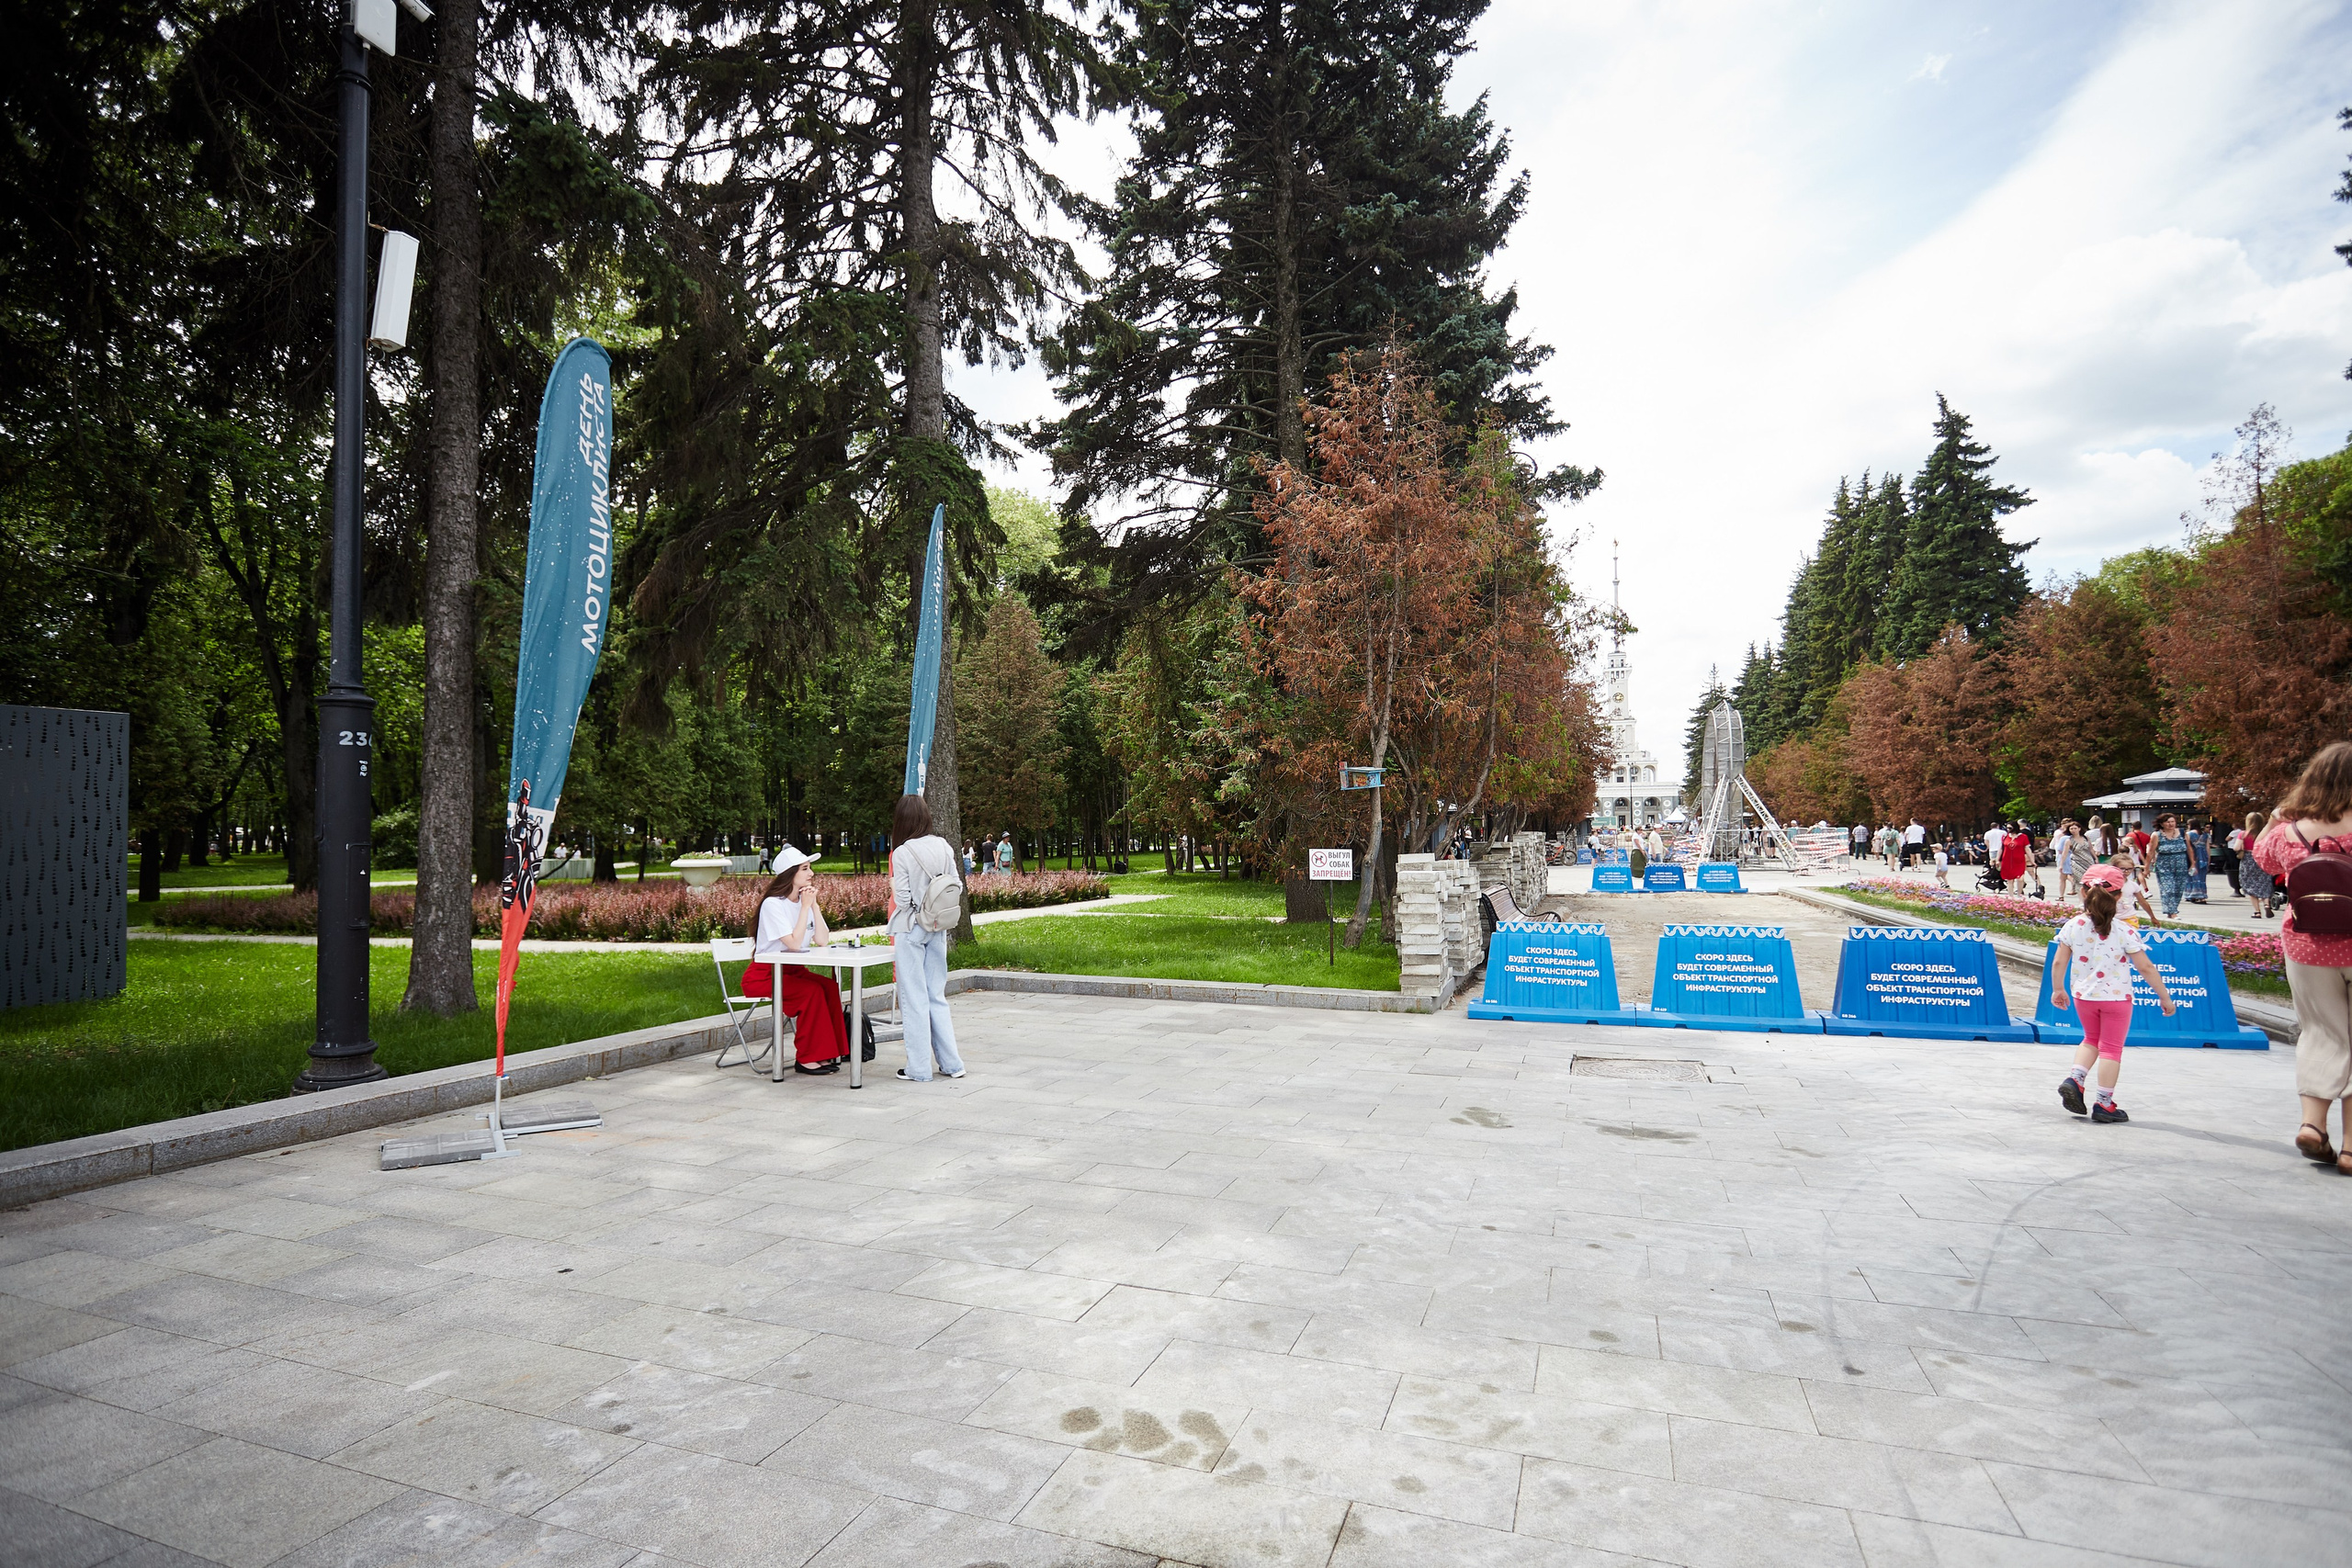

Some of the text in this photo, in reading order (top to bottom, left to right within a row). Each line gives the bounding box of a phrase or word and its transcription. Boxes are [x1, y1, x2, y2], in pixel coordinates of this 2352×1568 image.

[579, 372, 594, 467] ДЕНЬ
[580, 382, 610, 656] МОТОЦИКЛИСТА
[1312, 869, 1351, 878] ЗАПРЕЩЁН!
[1553, 948, 1578, 957] ЗДЕСЬ
[1508, 955, 1596, 967] БУДЕТ СОВРЕМЕННЫЙ
[1725, 954, 1754, 963] ЗДЕСЬ
[1504, 965, 1600, 977] ОБЪЕКТ ТРАНСПОРТНОЙ
[1677, 964, 1774, 974] БУДЕТ СОВРЕМЕННЫЙ
[1891, 963, 1956, 973] СКОРО ЗДЕСЬ
[2155, 964, 2177, 972] ЕСЬ
[1515, 976, 1588, 987] ИНФРАСТРУКТУРЫ
[1672, 974, 1779, 984] ОБЪЕКТ ТРАНСПОРТНОЙ
[1871, 974, 1978, 985] БУДЕТ СОВРЕМЕННЫЙ
[1685, 985, 1766, 994] ИНФРАСТРУКТУРЫ
[1866, 984, 1984, 996] ОБЪЕКТ ТРАНСПОРТНОЙ
[1881, 996, 1971, 1007] ИНФРАСТРУКТУРЫ
